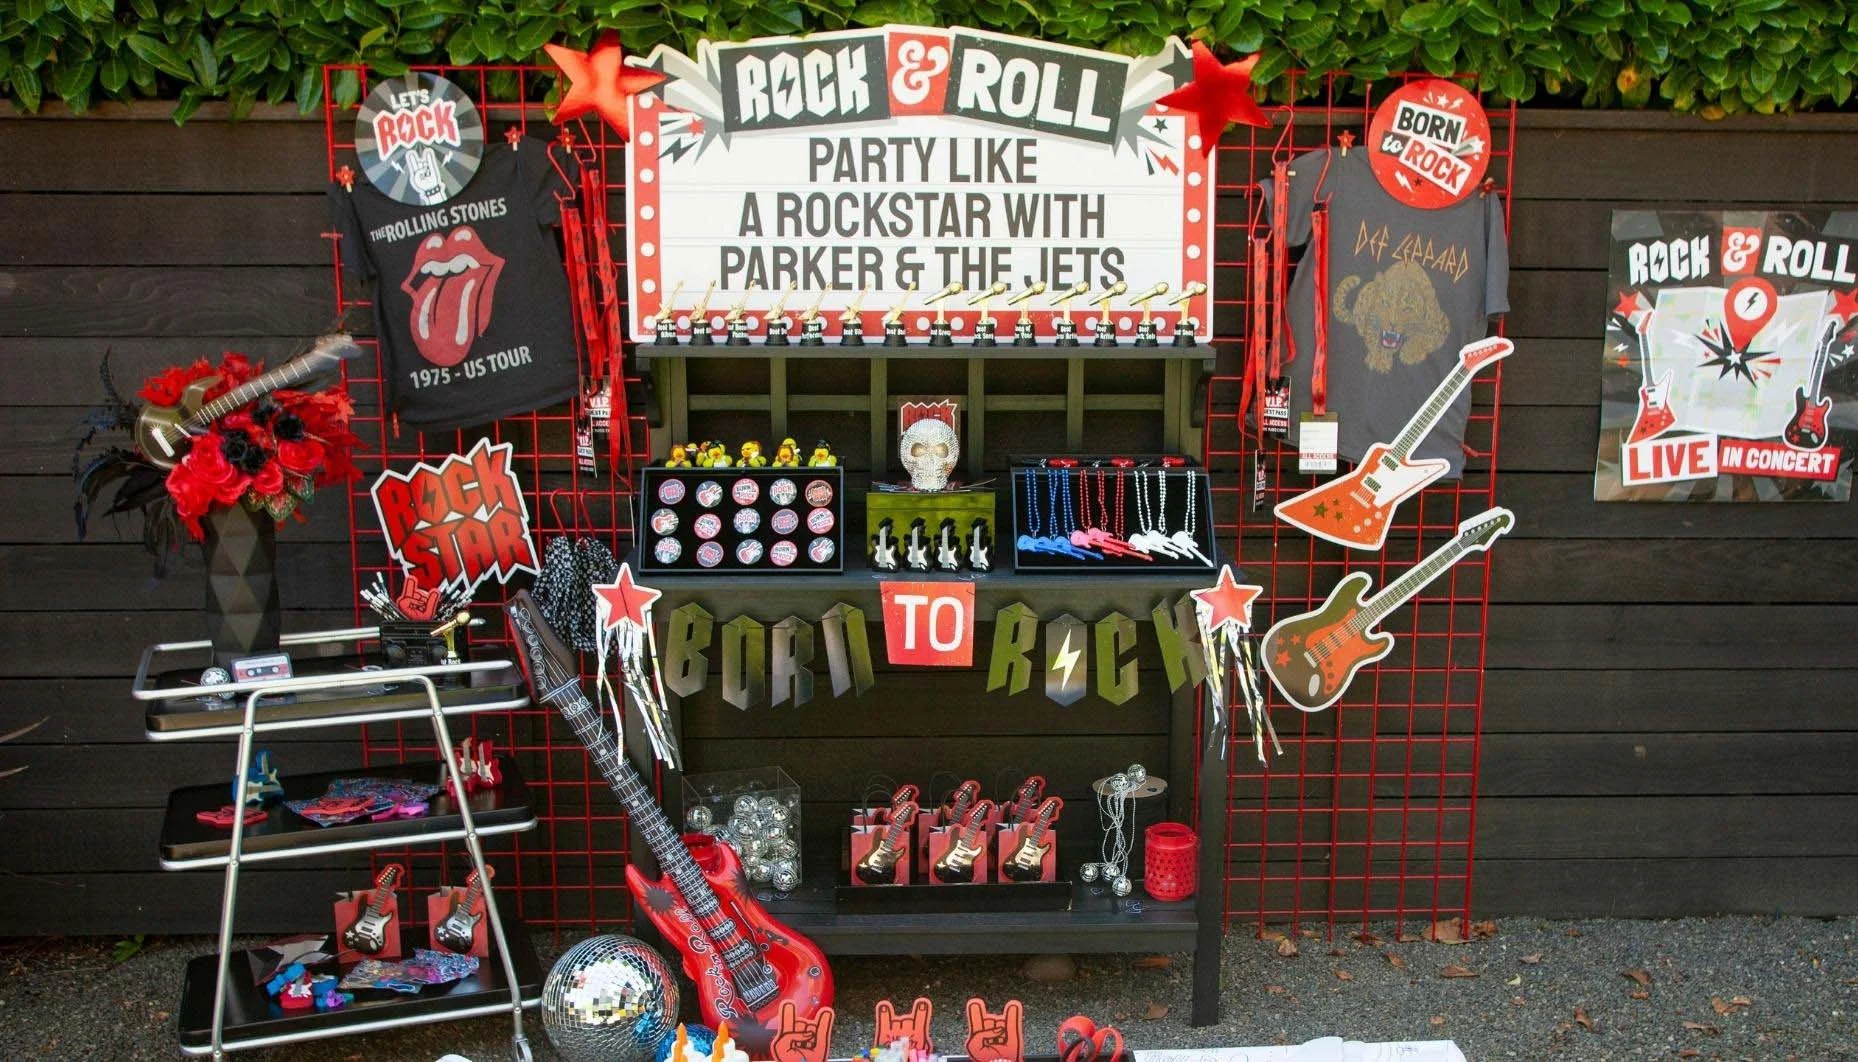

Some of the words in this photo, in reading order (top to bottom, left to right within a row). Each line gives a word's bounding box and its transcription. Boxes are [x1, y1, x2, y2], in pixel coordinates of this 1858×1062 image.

[390, 88, 430, 109] LET'S
[735, 46, 870, 124] ROCK
[892, 40, 948, 104] &
[957, 48, 1112, 130] ROLL
[376, 103, 458, 158] ROCK
[1397, 107, 1461, 144] BORN
[809, 137, 935, 183] PARTY
[950, 138, 1037, 183] LIKE
[1382, 135, 1403, 153] to
[1404, 139, 1466, 189] ROCK
[370, 226, 387, 242] THE
[384, 208, 449, 242] ROLLING
[450, 197, 507, 224] STONES
[739, 193, 763, 237] A
[777, 192, 992, 238] ROCKSTAR
[1002, 194, 1105, 238] WITH
[720, 246, 885, 290] PARKER
[895, 247, 925, 290] &
[931, 247, 1014, 290] THE
[1023, 247, 1125, 291] JETS
[1354, 219, 1389, 263] DEF
[1392, 232, 1469, 284] LEPPARD
[1628, 234, 1710, 286] ROCK
[1723, 231, 1761, 272] &
[1762, 235, 1856, 284] ROLL
[409, 367, 451, 389] 1975
[463, 358, 487, 379] US
[487, 345, 532, 373] TOUR
[1275, 409, 1287, 417] PASS
[1628, 440, 1710, 481] LIVE
[1722, 447, 1741, 468] IN
[1745, 448, 1836, 474] CONCERT
[376, 444, 524, 548] ROCK
[402, 510, 536, 592] STAR
[665, 602, 874, 710] BORN
[894, 595, 964, 652] TO
